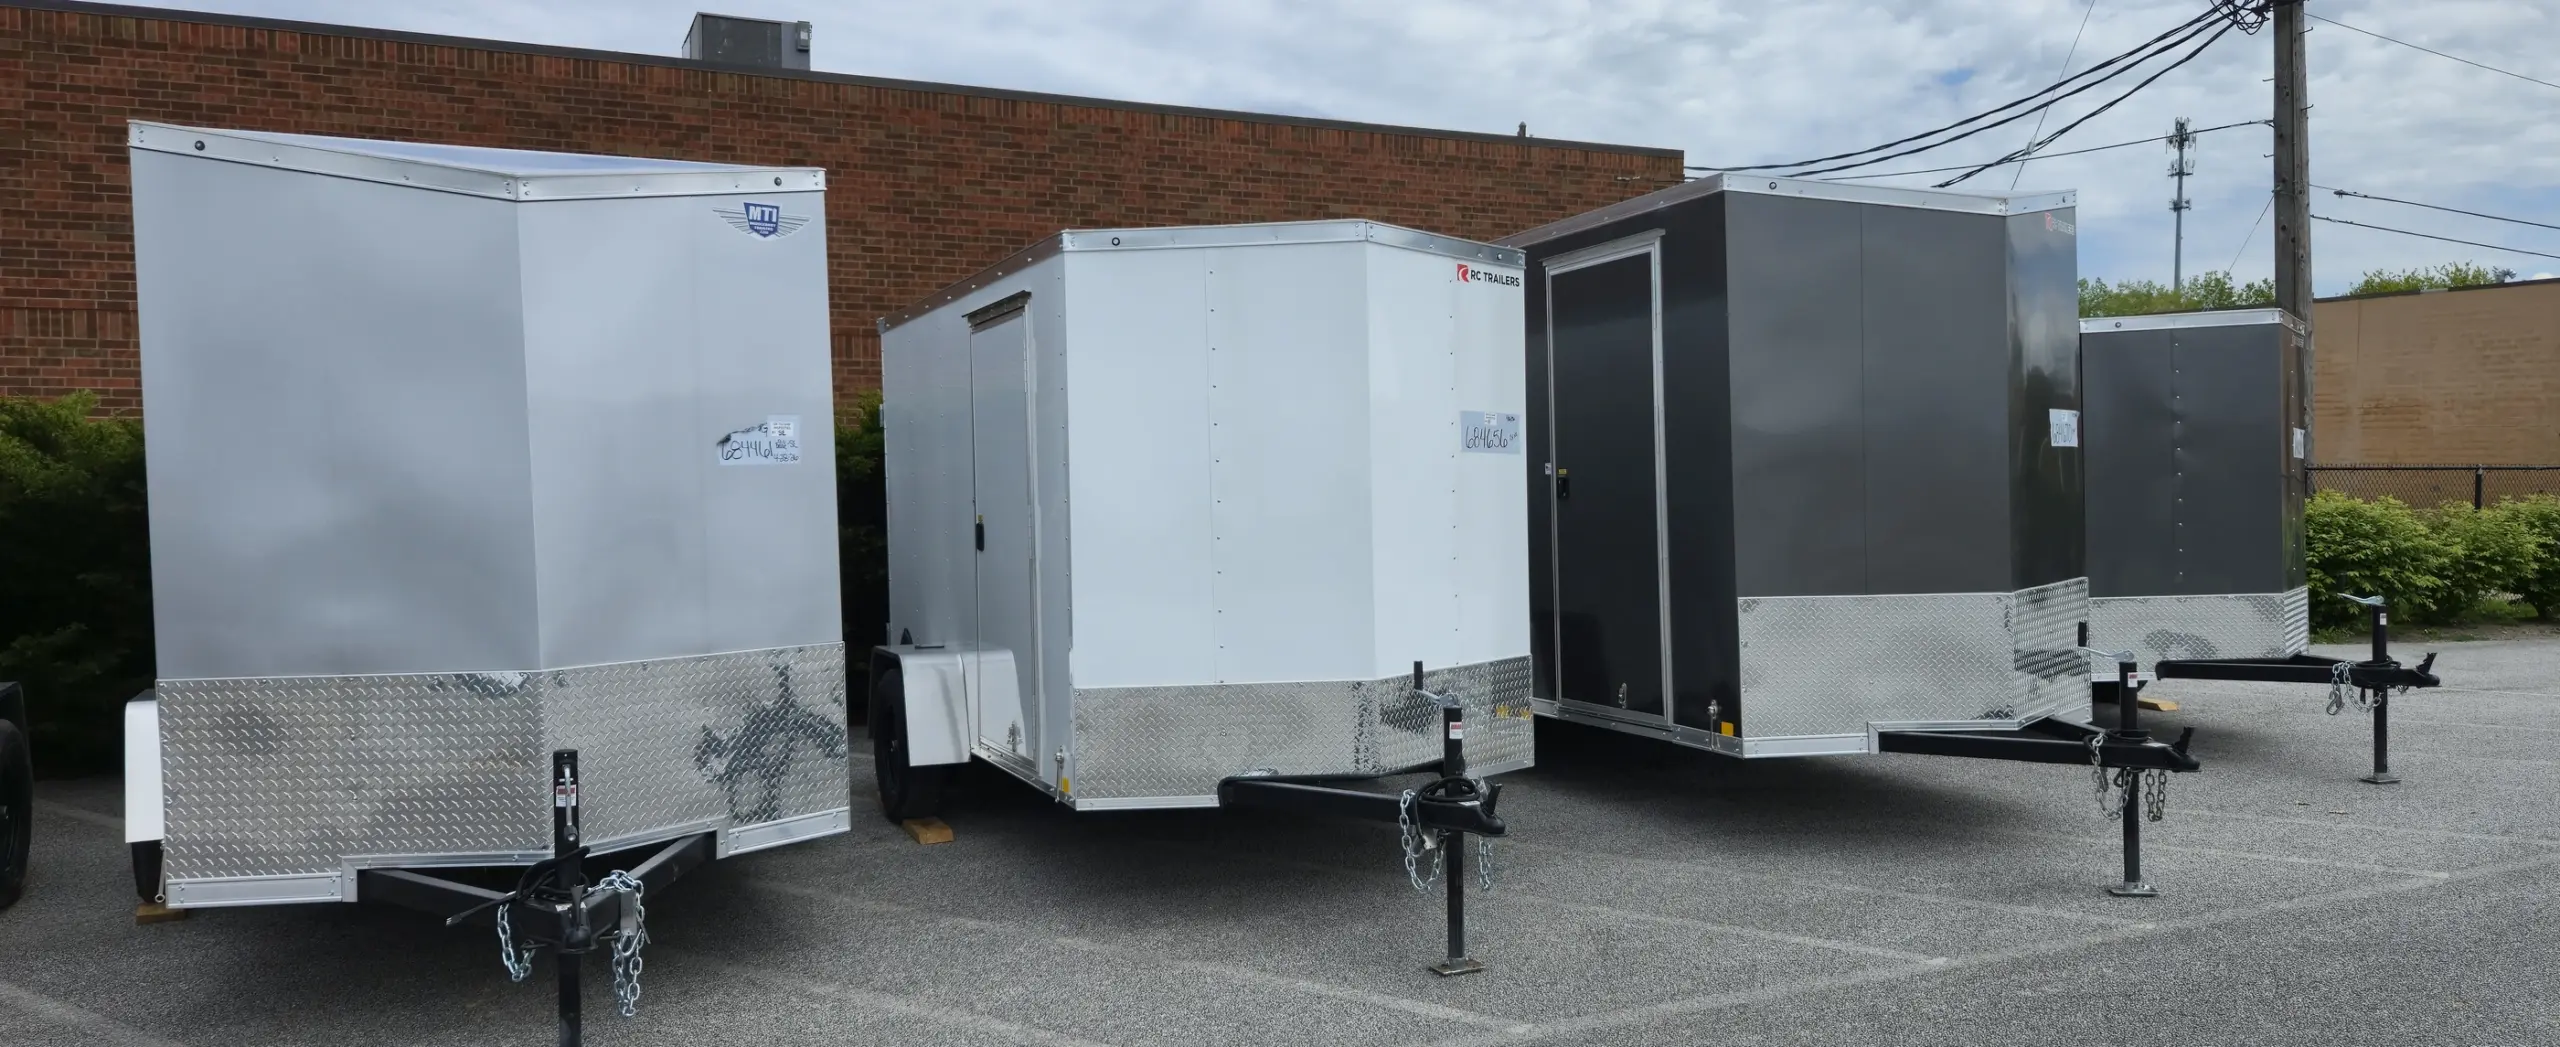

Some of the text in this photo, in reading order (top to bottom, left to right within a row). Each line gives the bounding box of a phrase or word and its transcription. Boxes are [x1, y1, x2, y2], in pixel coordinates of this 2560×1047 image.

[749, 205, 777, 222] MTI
[1470, 269, 1520, 287] RC TRAILERS
[1465, 425, 1508, 449] 684656
